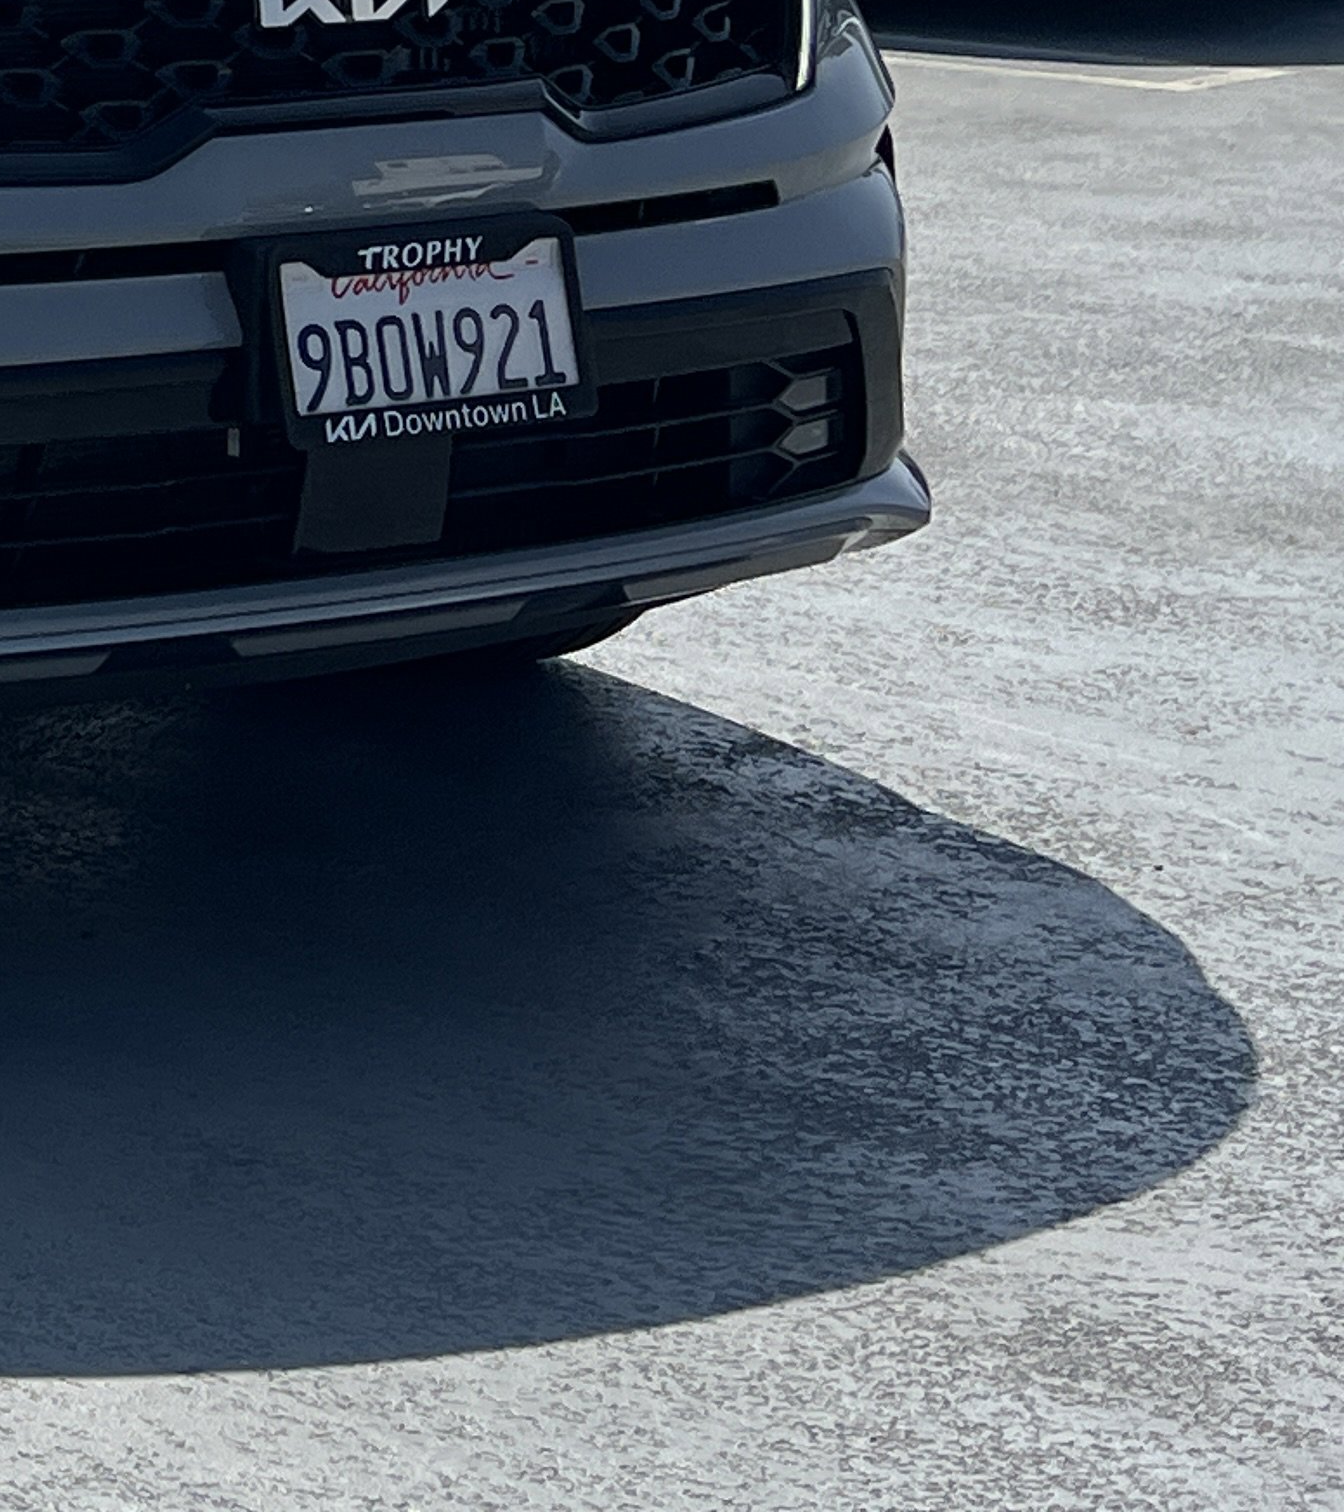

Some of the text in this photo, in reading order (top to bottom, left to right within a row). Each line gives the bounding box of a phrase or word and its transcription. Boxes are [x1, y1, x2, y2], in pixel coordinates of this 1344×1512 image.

[357, 235, 483, 270] TROPHY
[297, 299, 567, 413] 9BOW921
[325, 391, 567, 443] KIA Downtown LA
